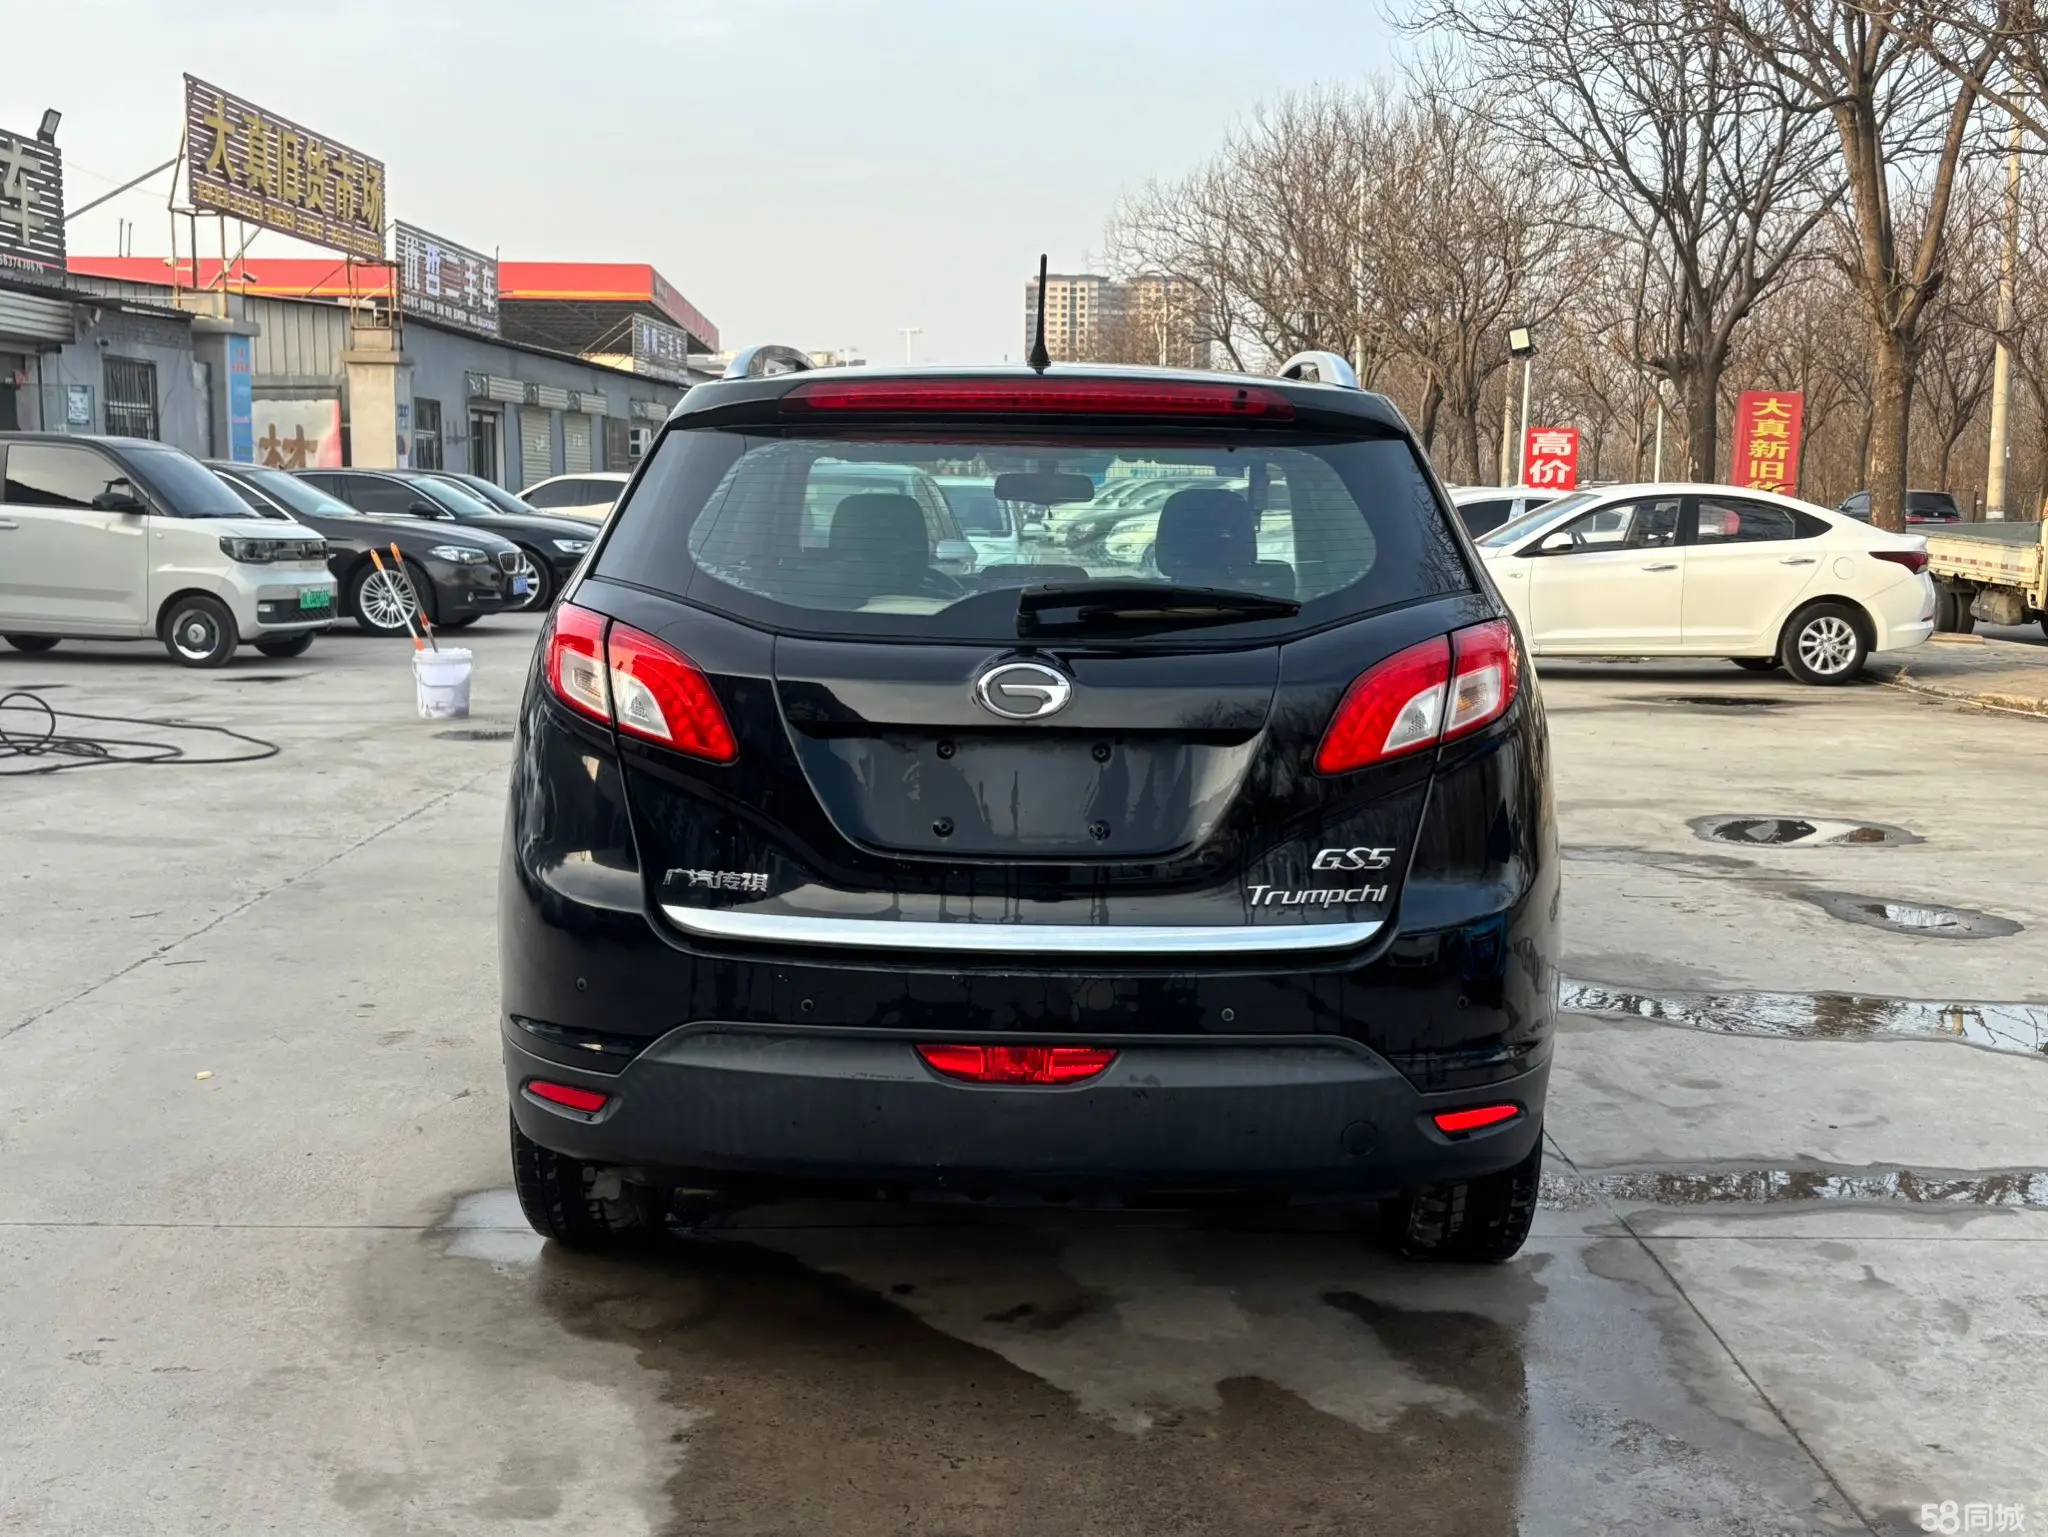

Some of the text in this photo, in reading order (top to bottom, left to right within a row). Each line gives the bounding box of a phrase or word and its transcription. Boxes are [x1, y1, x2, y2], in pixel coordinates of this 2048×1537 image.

[203, 96, 383, 235] 大真旧货市场
[1529, 431, 1574, 490] 高价
[1312, 847, 1396, 870] GS5
[662, 868, 768, 892] 广汽传祺
[1247, 884, 1389, 909] Trumpchi
